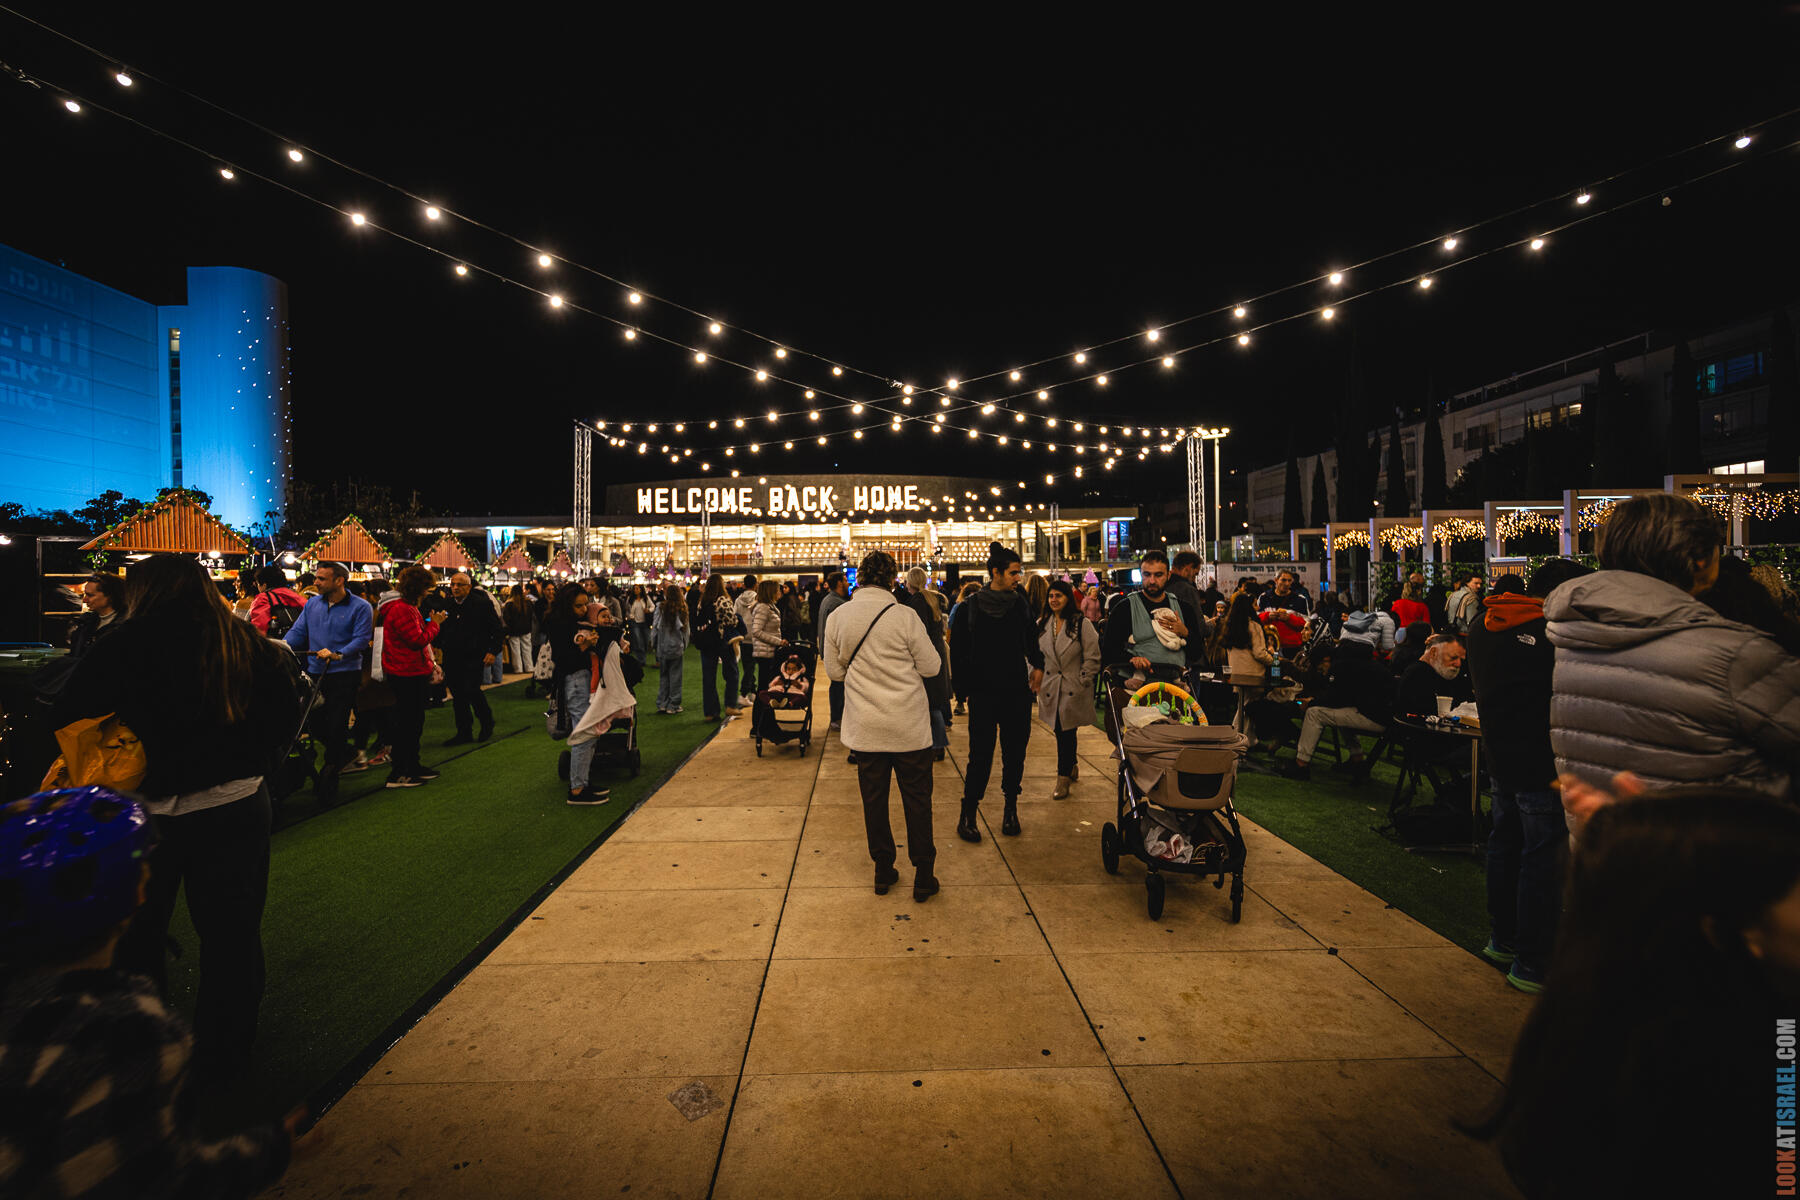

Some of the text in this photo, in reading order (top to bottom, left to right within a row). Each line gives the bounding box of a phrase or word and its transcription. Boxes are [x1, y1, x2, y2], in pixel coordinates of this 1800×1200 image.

[637, 485, 918, 514] WELCOME BACK HOME
